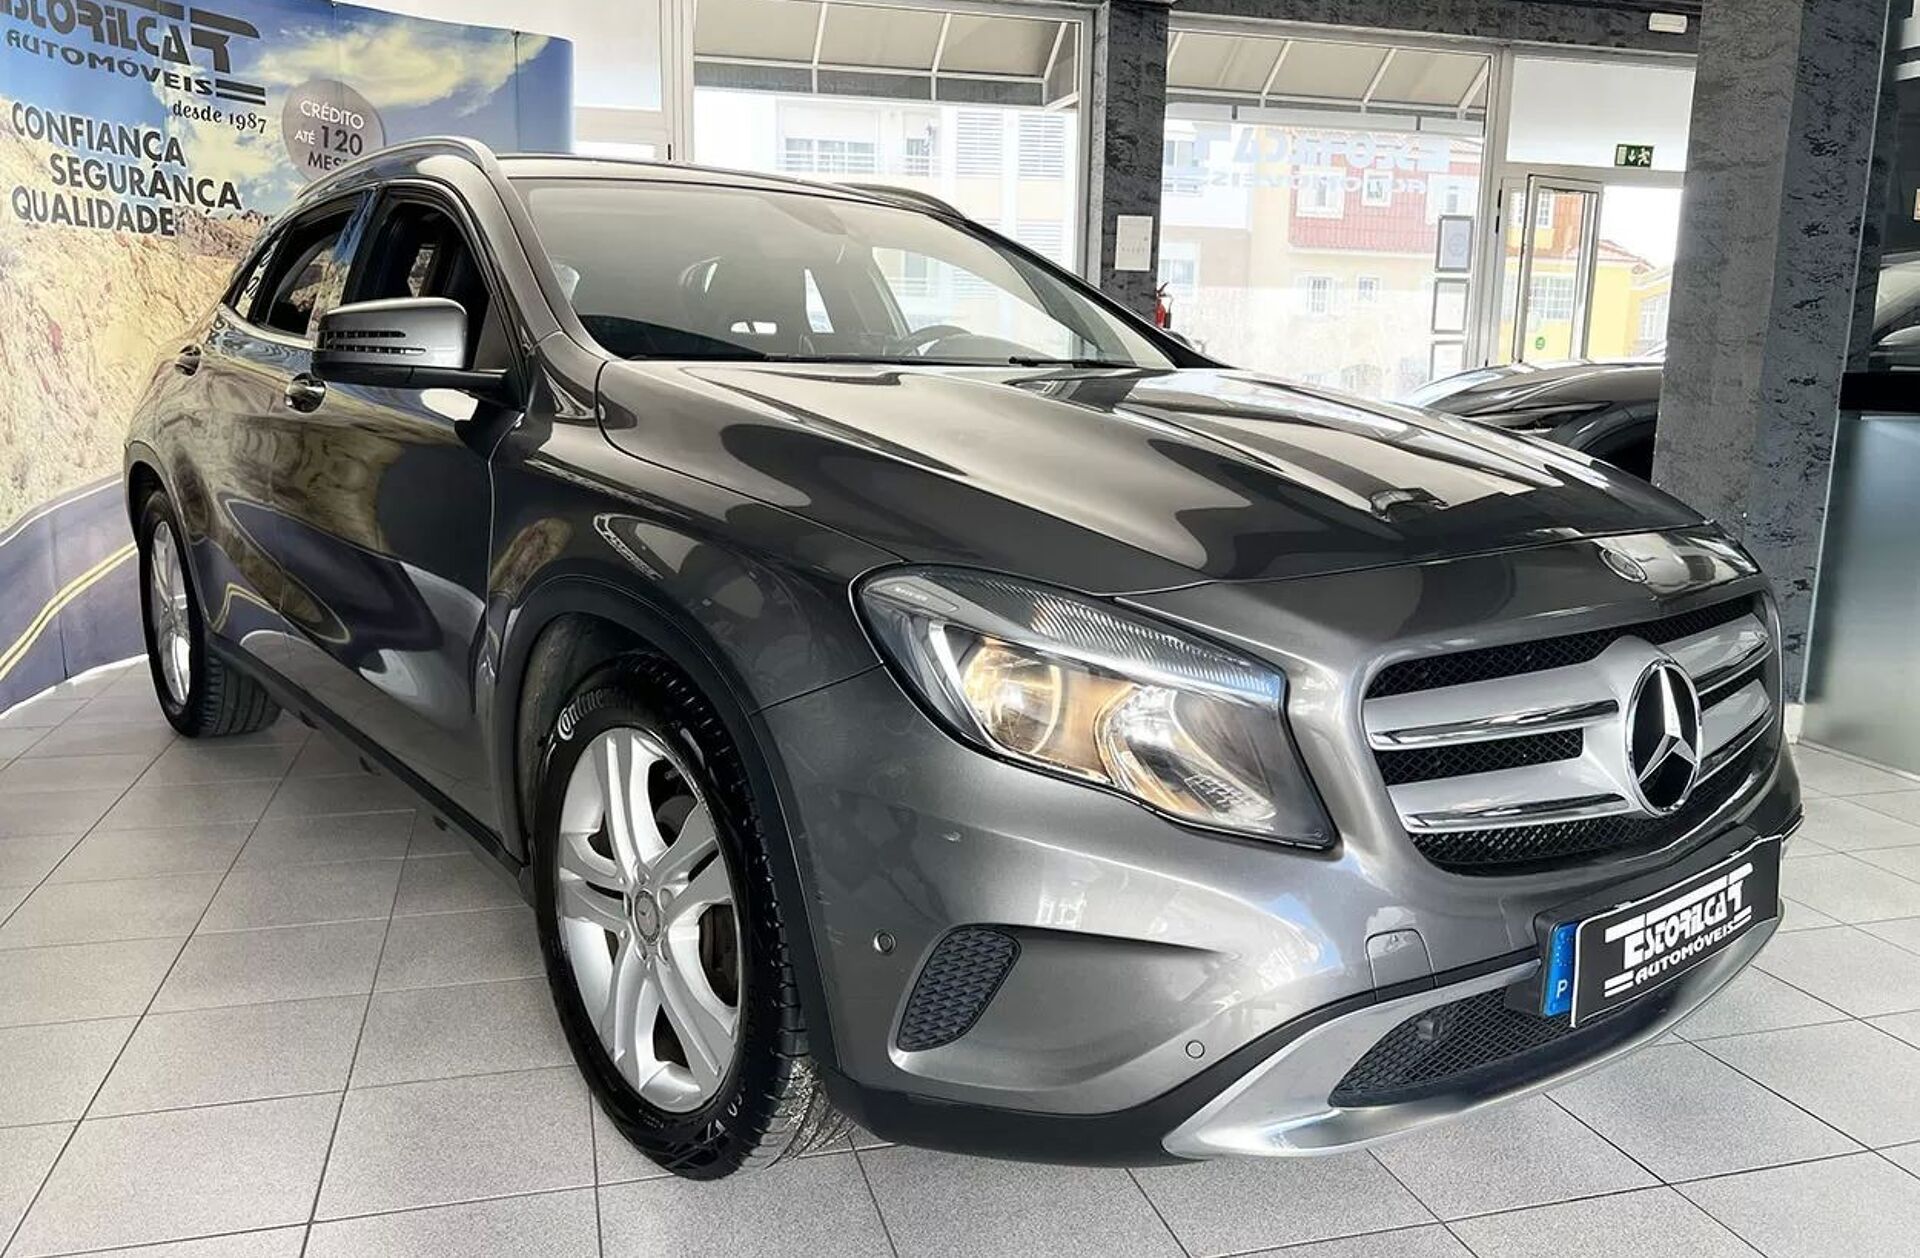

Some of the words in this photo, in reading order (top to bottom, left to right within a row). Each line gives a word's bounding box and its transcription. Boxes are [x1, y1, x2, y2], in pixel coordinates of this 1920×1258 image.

[7, 28, 216, 98] AUTOMÓVEIS
[12, 101, 186, 167] CONFIANÇA
[172, 100, 223, 124] desde
[228, 112, 267, 135] 1987
[294, 130, 316, 145] ATÉ
[321, 125, 363, 156] 120
[300, 100, 365, 130] CRÉDITO
[12, 185, 175, 237] QUALIDADE
[50, 153, 242, 217] SEGURANÇA
[1635, 921, 1735, 985] AUTOMÓVEIS
[1557, 980, 1568, 998] P
